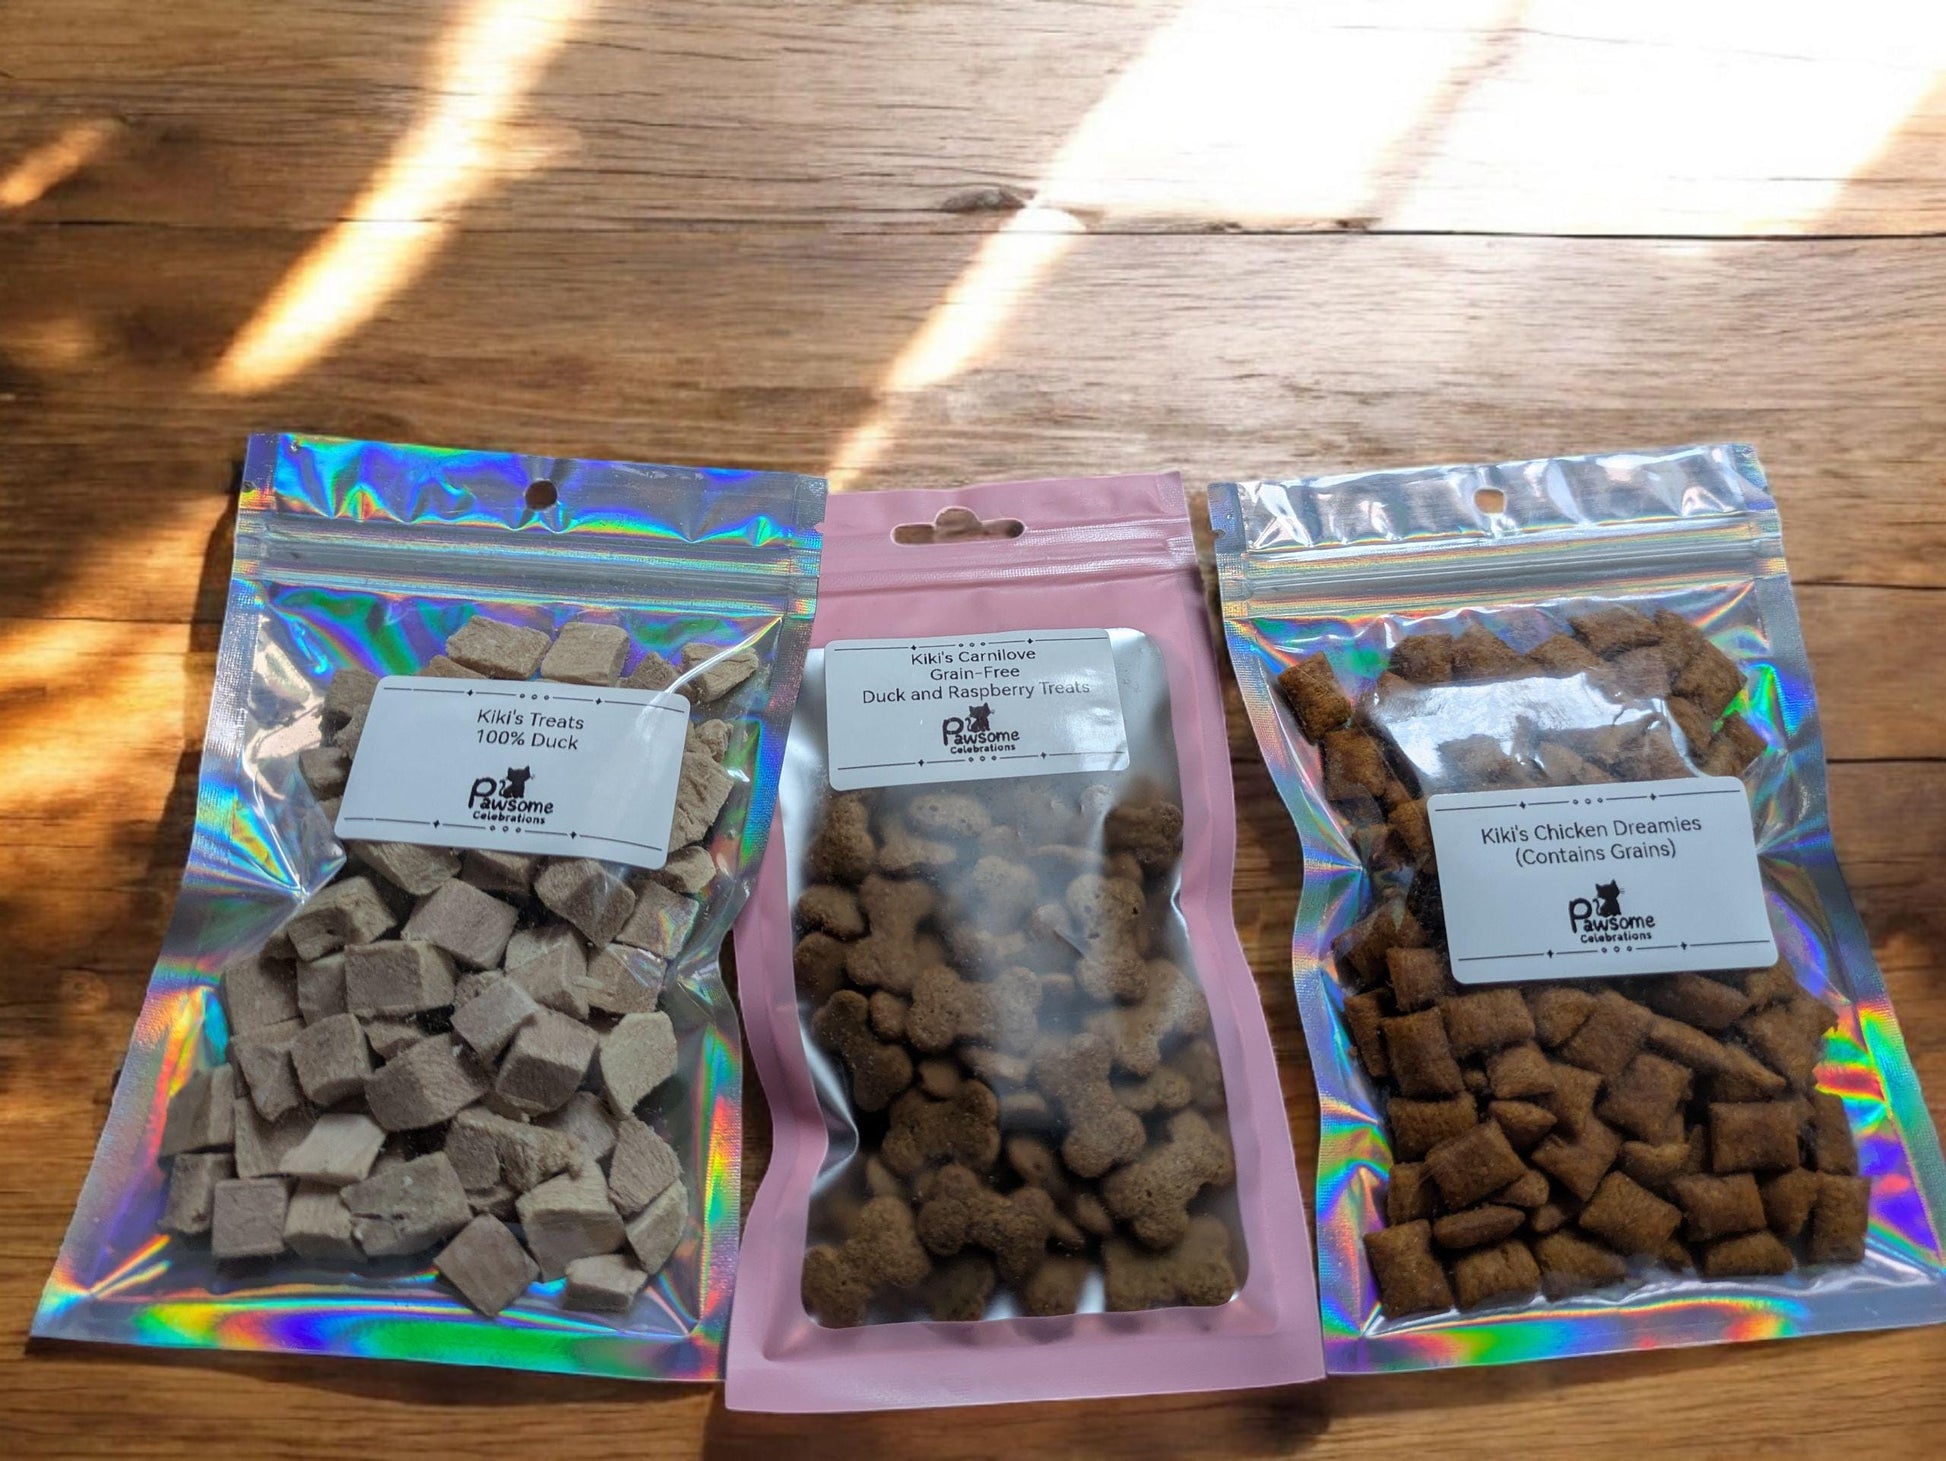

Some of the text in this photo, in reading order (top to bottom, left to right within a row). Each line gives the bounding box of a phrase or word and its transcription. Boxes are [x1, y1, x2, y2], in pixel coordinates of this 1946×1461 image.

[911, 648, 1037, 666] Kiki's Carnilove
[930, 665, 1021, 681] Grain-Free
[863, 680, 1091, 704] Duck and Raspberry Treats
[476, 709, 584, 730] Kiki's Treats
[476, 729, 579, 750] 100% Duck
[942, 716, 1020, 746] Pawsome
[950, 743, 1016, 755] Celebrations
[468, 776, 554, 814] Pawsome
[472, 810, 546, 825] Celebrations
[1481, 817, 1702, 845] Kiki's Chicken Dreamies
[1515, 838, 1677, 868] (Contains Grains)
[1568, 897, 1656, 934] Pawsome
[1580, 931, 1653, 944] Celebrations
